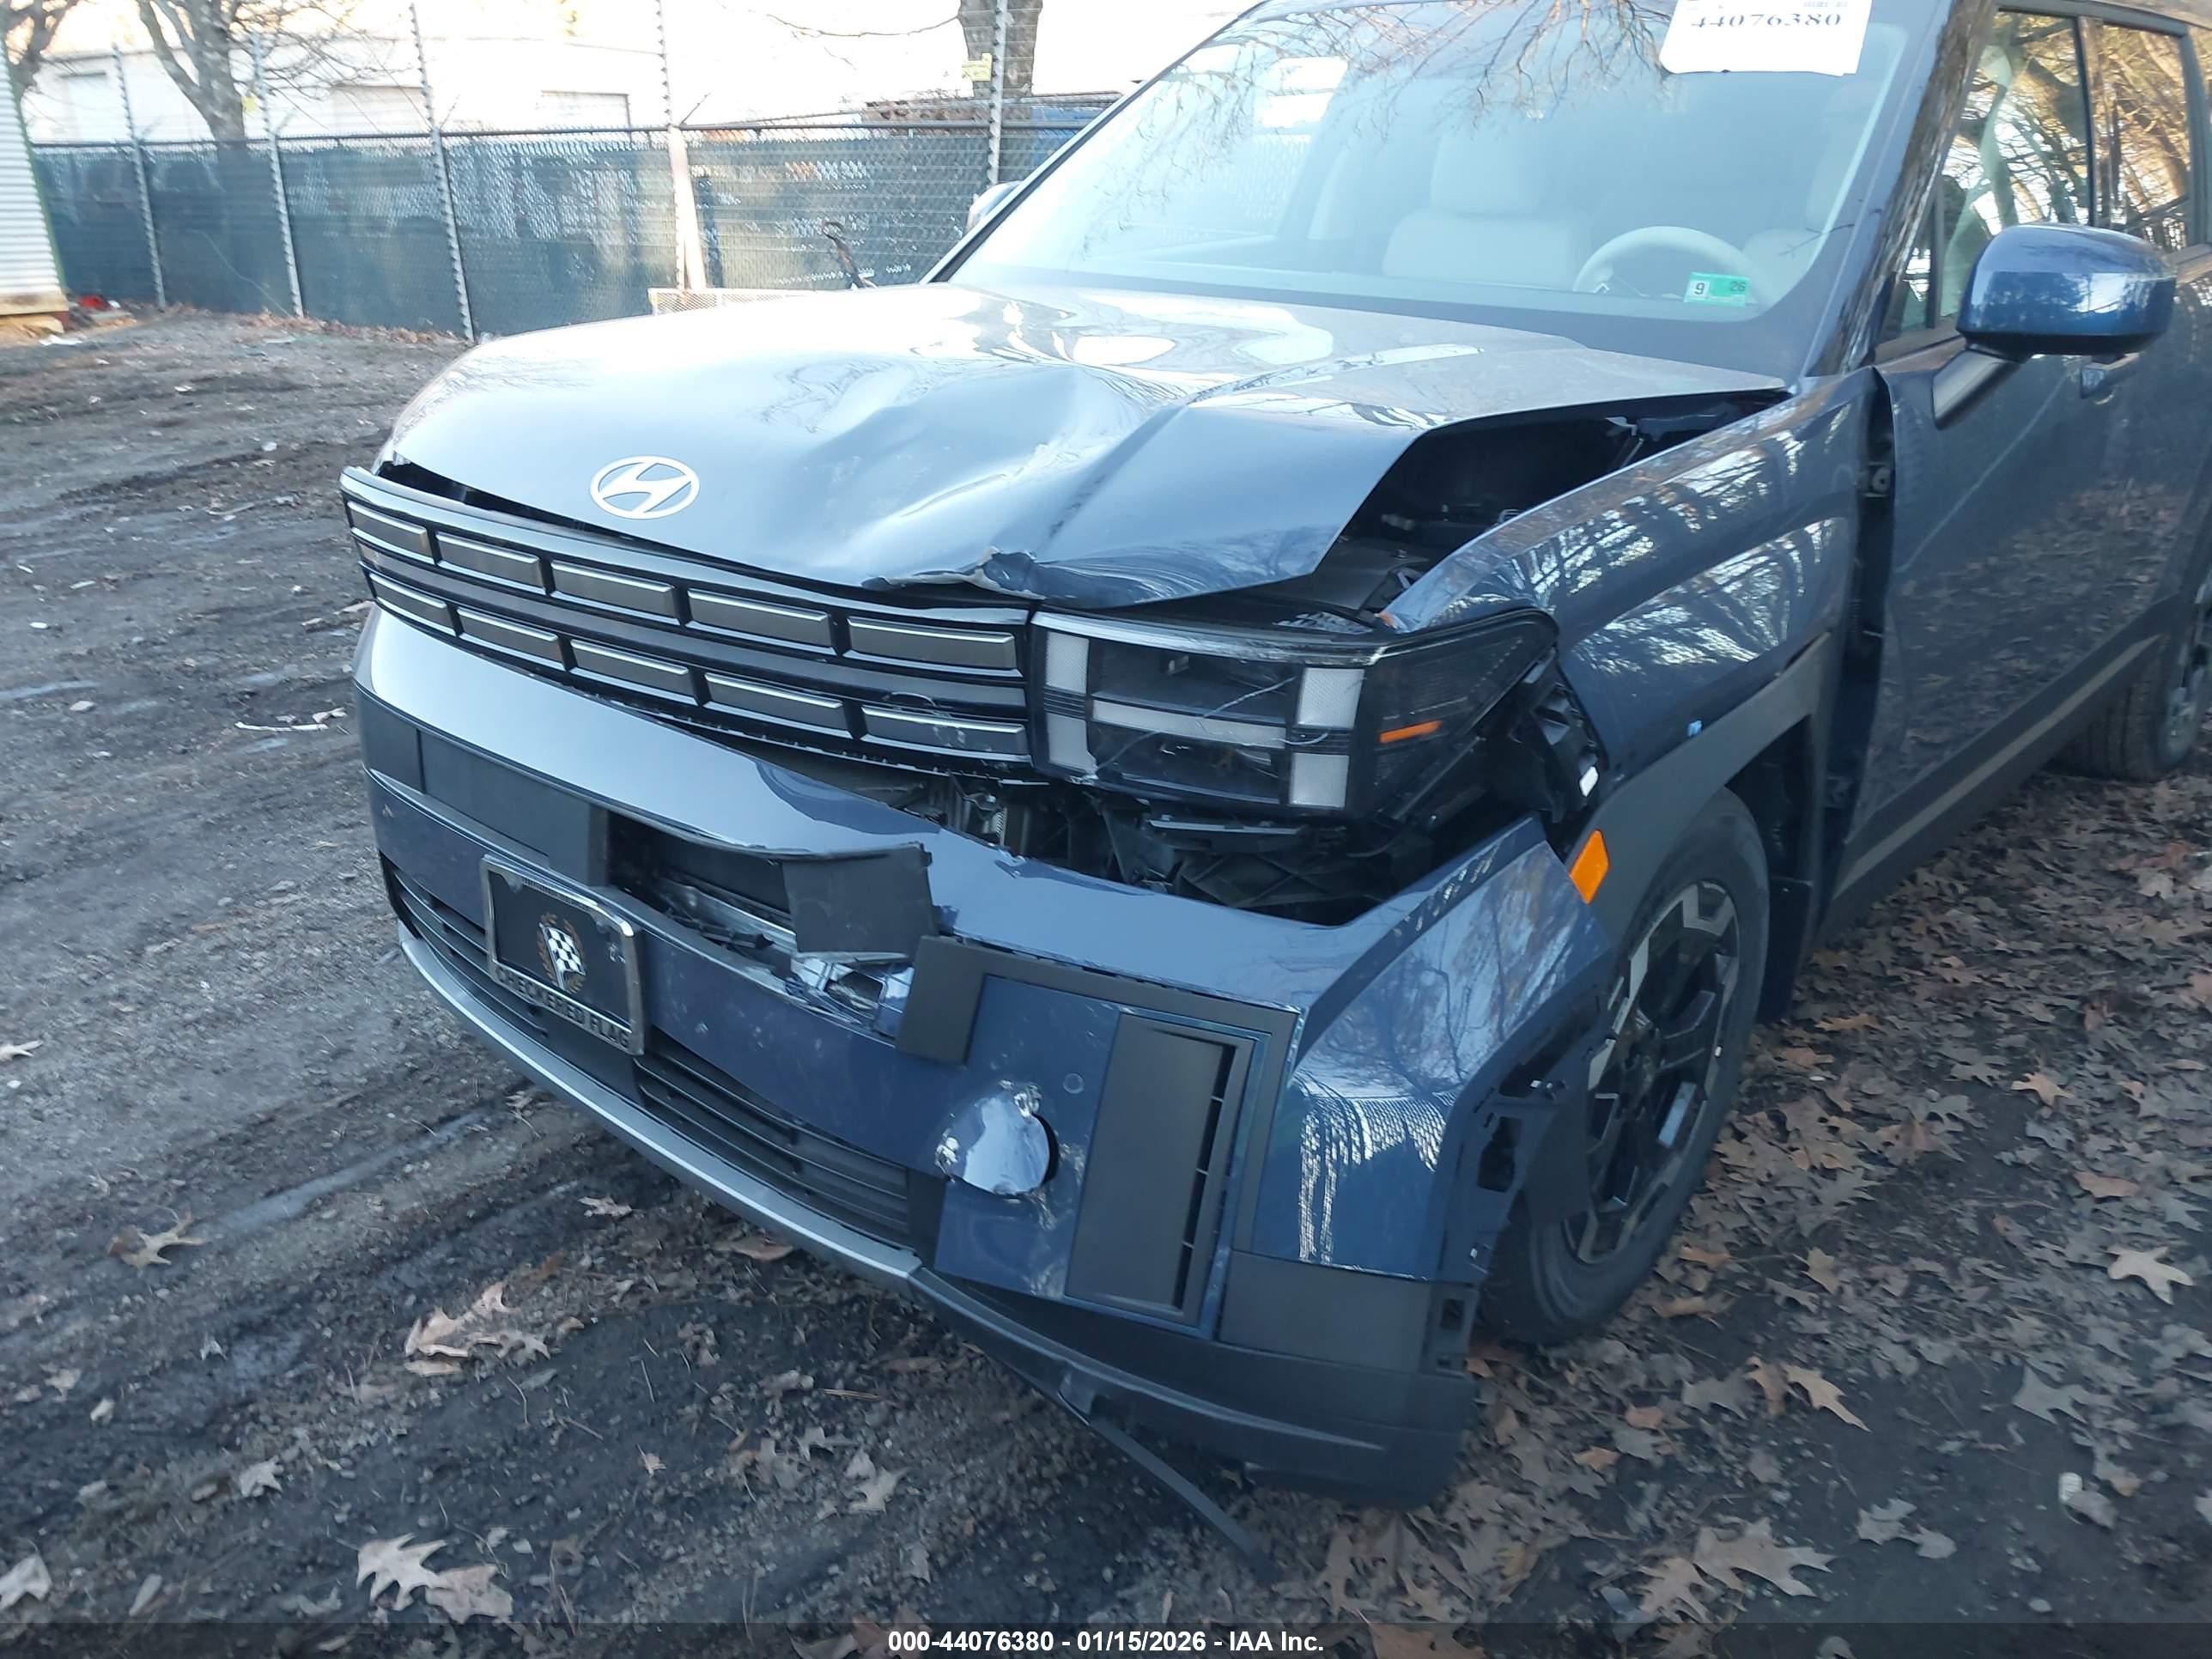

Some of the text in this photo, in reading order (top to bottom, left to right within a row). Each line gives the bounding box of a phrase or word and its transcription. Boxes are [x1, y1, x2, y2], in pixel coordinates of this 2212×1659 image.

[1691, 13, 1842, 27] 44076380
[1694, 281, 1747, 295] 9 26
[588, 1016, 631, 1049] FLAG
